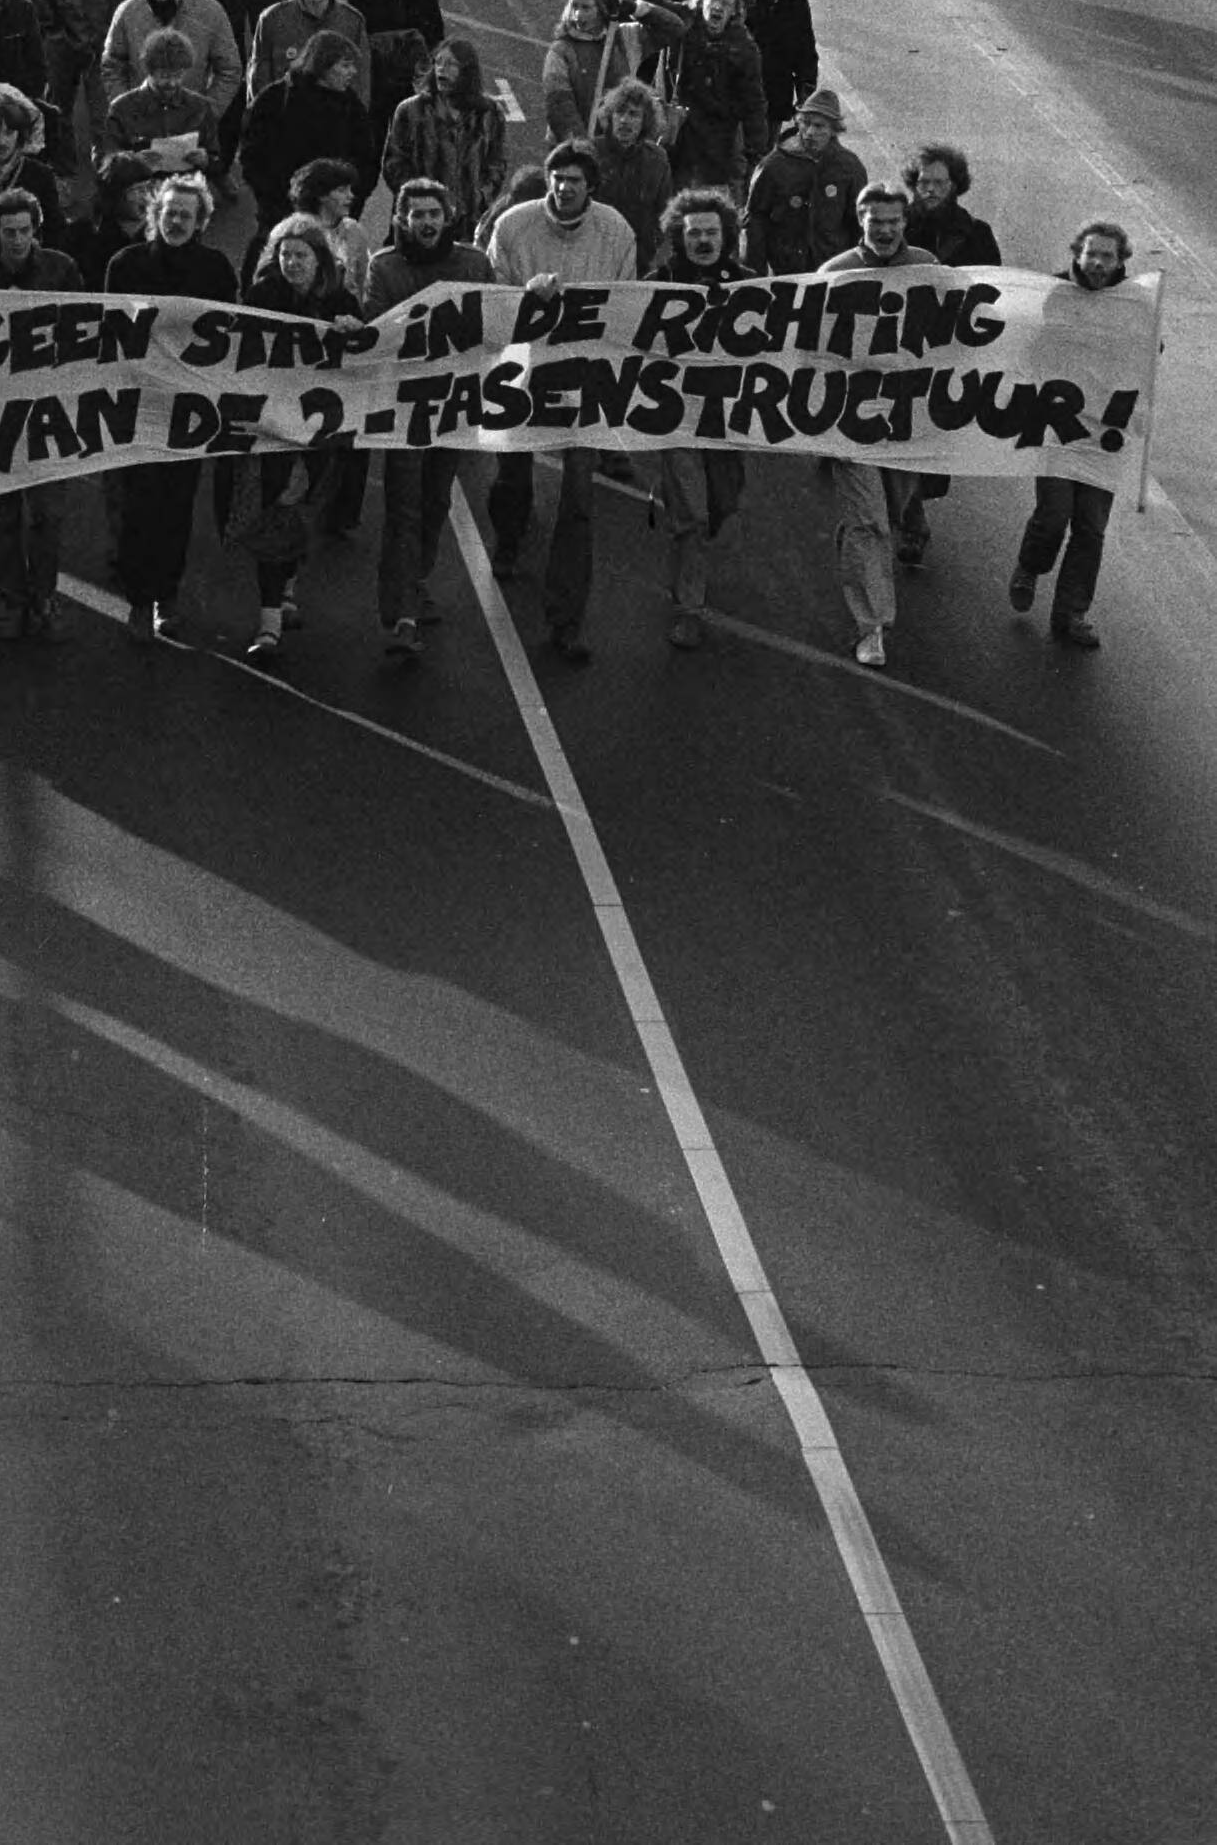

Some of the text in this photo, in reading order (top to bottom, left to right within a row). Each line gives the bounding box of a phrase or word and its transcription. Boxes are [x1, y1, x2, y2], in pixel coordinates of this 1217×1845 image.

[180, 309, 380, 373] STAP
[510, 288, 611, 347] DE
[167, 391, 269, 454] DE
